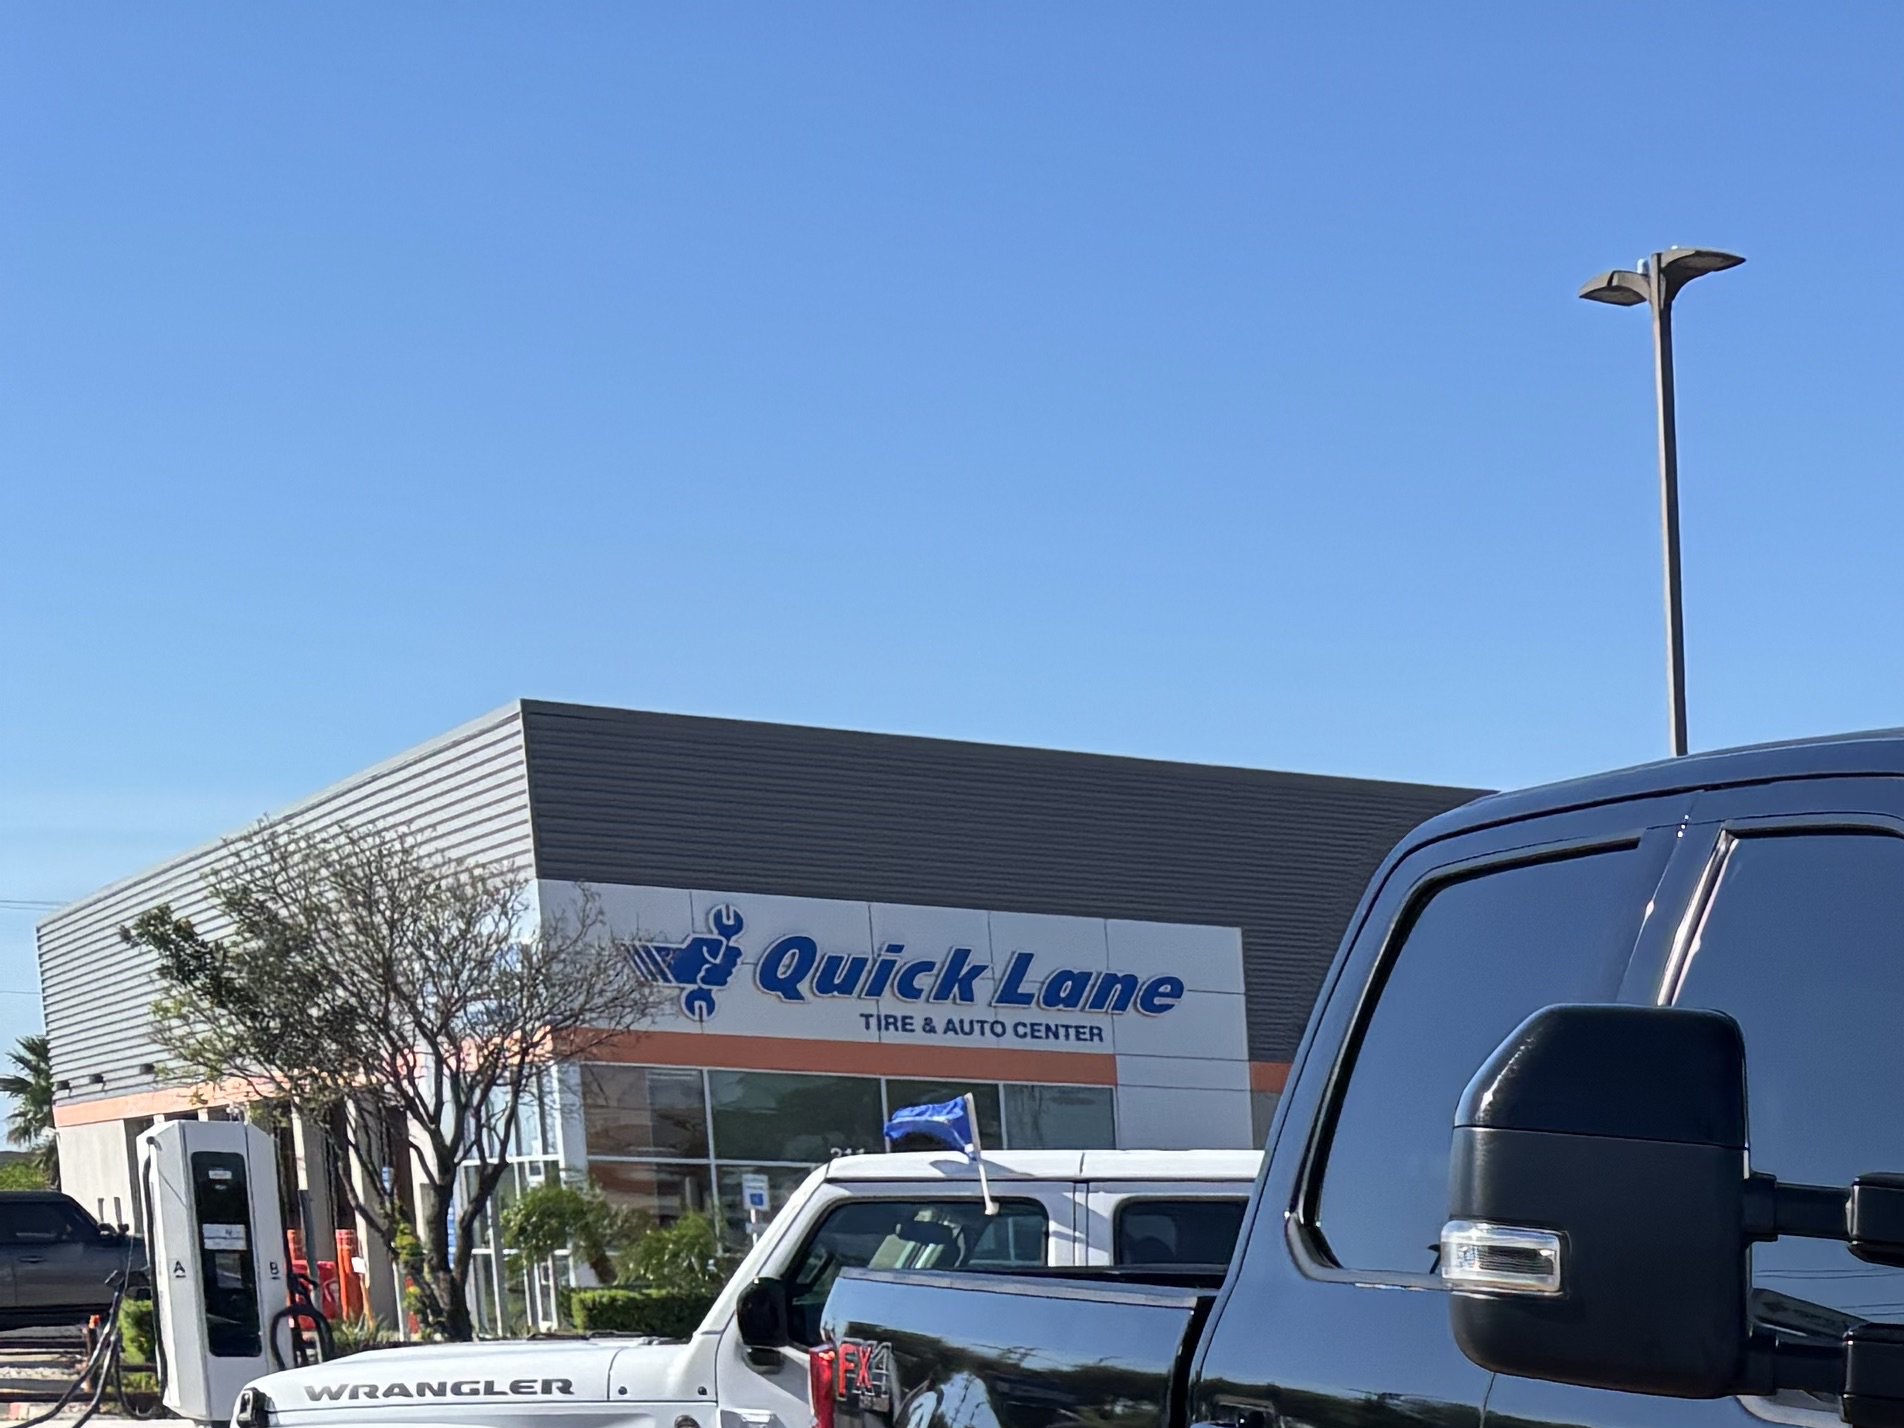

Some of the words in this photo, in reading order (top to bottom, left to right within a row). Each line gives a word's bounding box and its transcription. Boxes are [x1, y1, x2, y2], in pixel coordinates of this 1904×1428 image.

[757, 935, 989, 1002] Quick
[993, 951, 1185, 1015] Lane
[859, 1013, 916, 1034] TIRE
[921, 1017, 938, 1036] &
[943, 1019, 1008, 1039] AUTO
[1013, 1022, 1105, 1043] CENTER
[173, 1260, 186, 1273] A
[269, 1261, 280, 1275] B
[837, 1338, 892, 1401] FX4
[304, 1378, 576, 1402] WRANGLER
